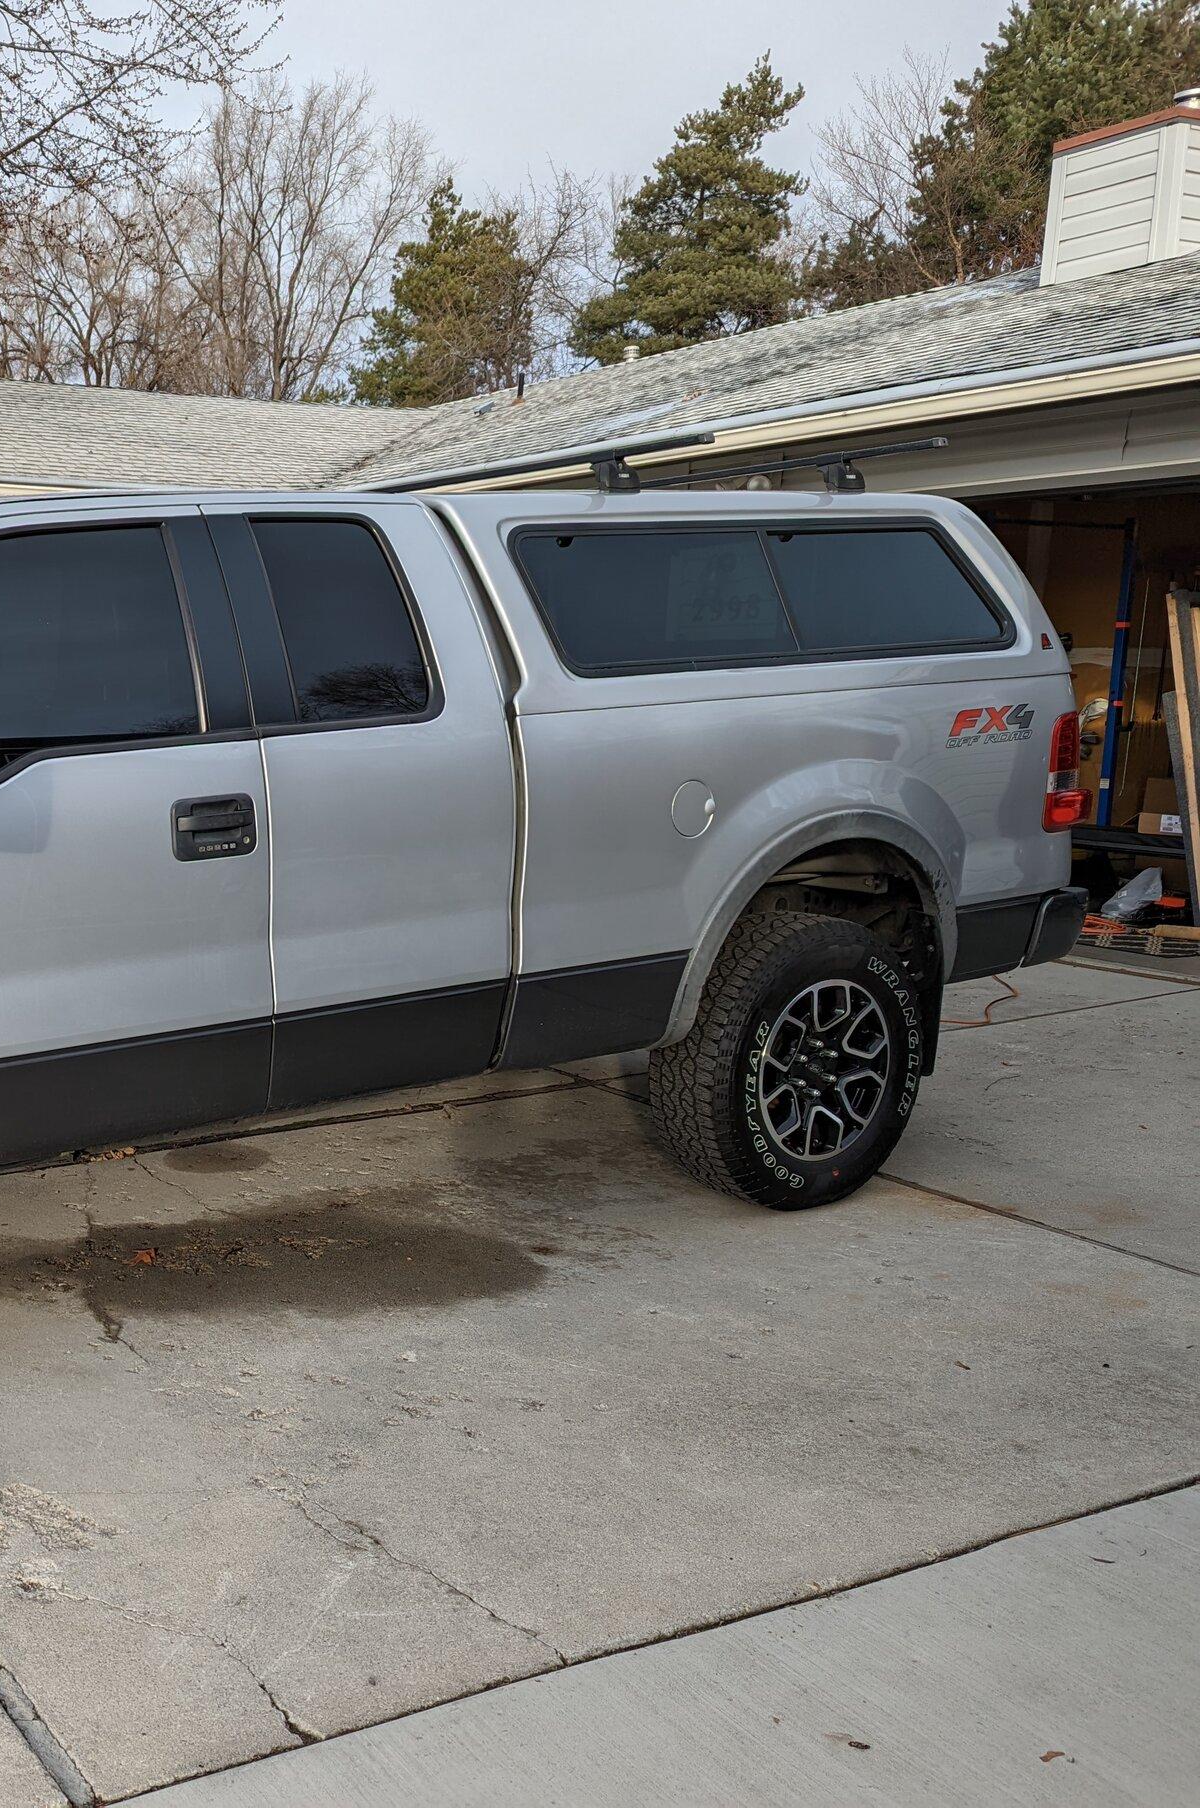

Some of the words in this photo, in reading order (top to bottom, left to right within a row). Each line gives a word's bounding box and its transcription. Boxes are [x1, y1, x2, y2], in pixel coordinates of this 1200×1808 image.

[945, 735, 981, 749] OFF
[984, 729, 1034, 745] ROAD
[948, 703, 1035, 738] FX4
[866, 956, 920, 1117] WRANGLER
[745, 1020, 804, 1189] GOODYEAR
